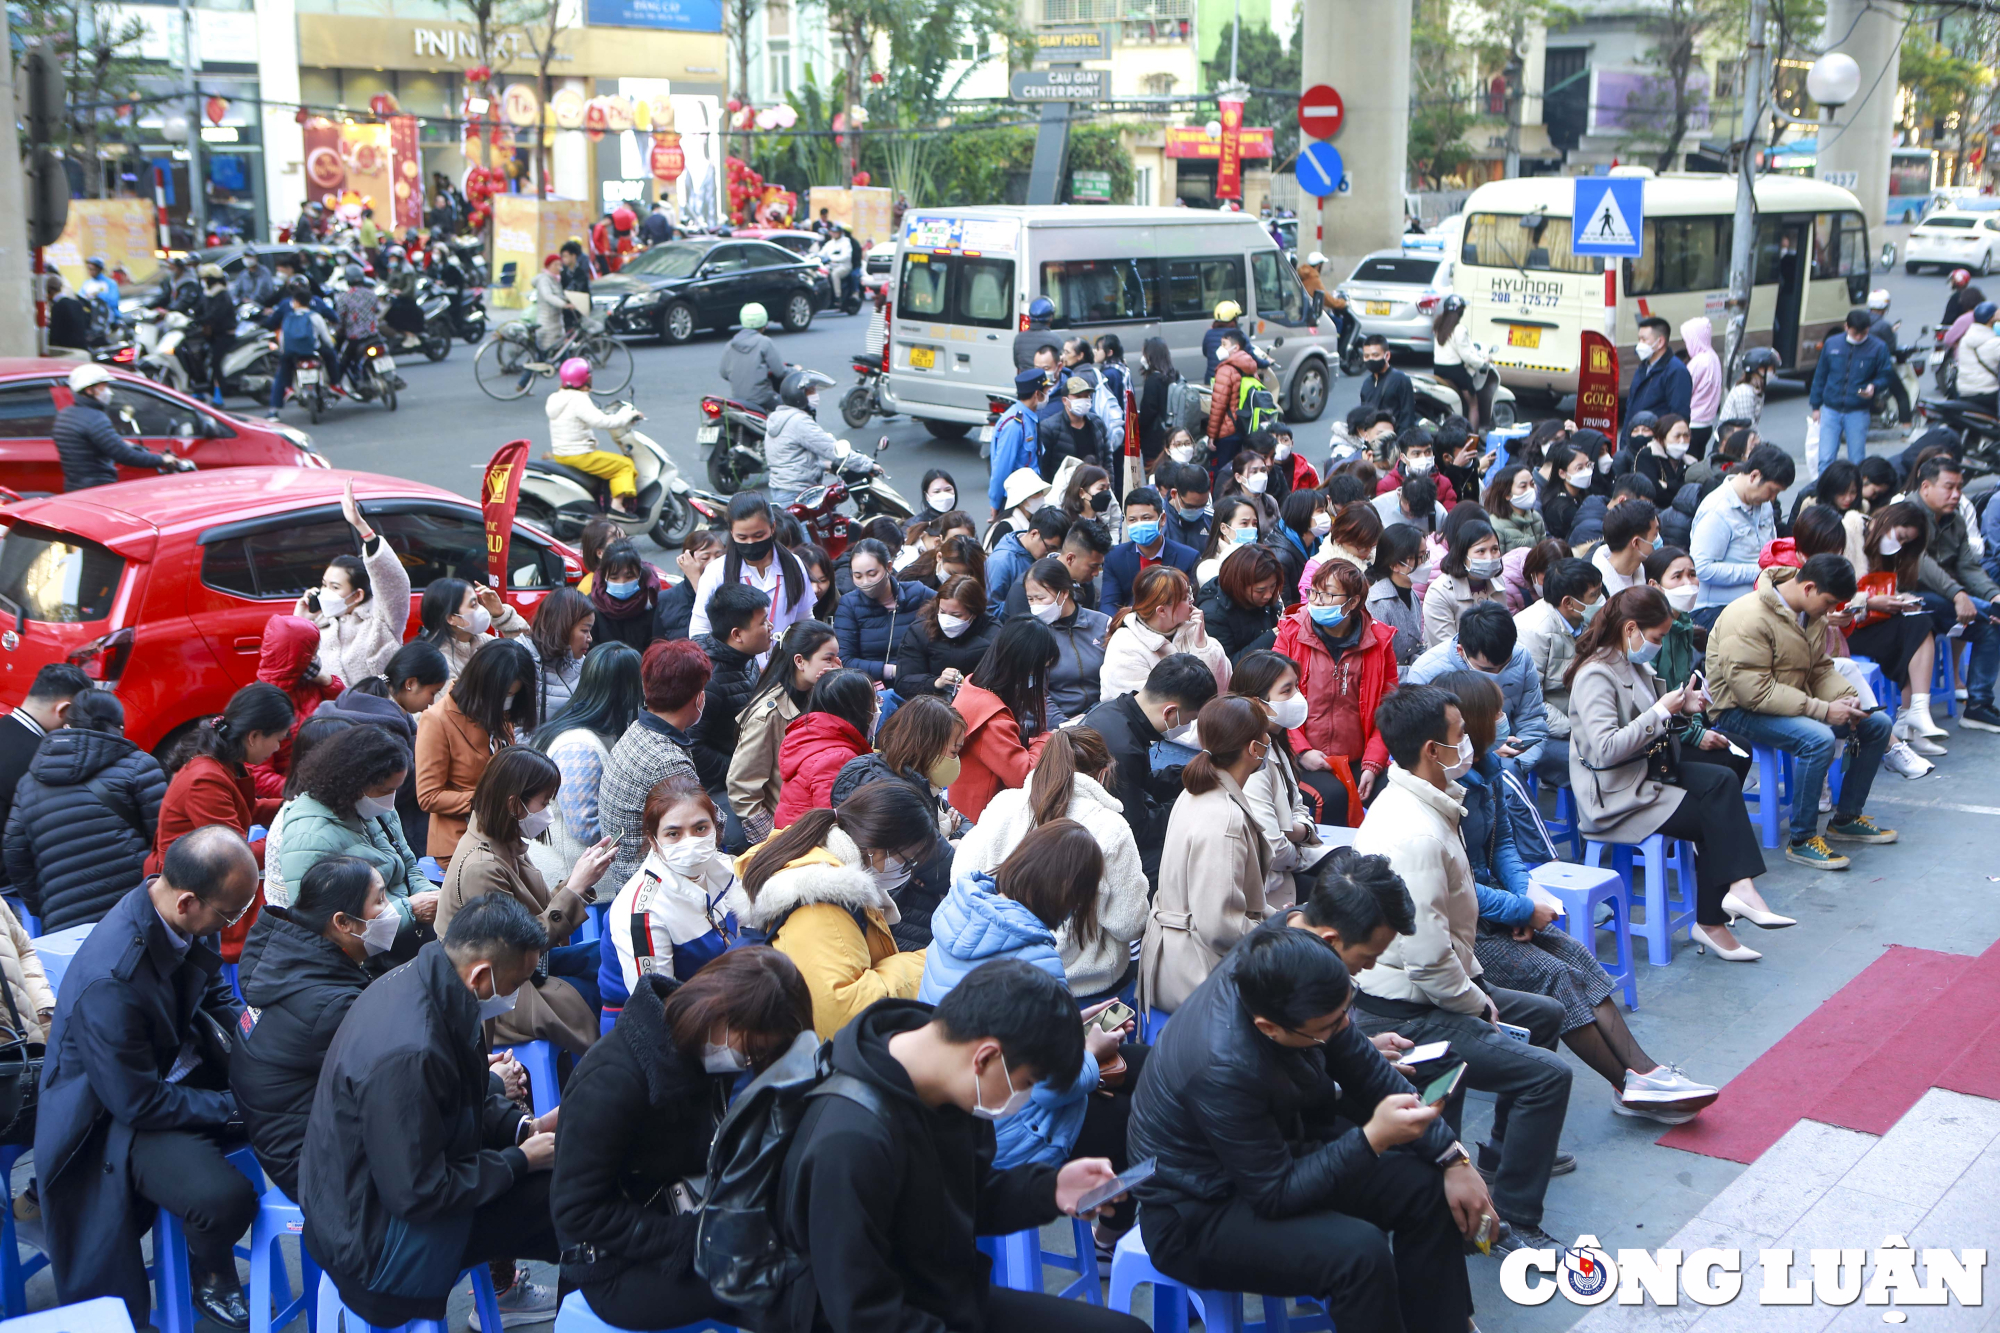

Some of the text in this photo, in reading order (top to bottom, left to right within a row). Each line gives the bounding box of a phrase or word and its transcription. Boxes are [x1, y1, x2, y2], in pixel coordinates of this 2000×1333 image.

[414, 28, 455, 62] PNJ
[1038, 34, 1062, 47] GIAY
[1063, 33, 1100, 46] HOTEL
[1048, 72, 1100, 85] CAU GIAY
[1491, 277, 1563, 295] HYUNDAI
[1522, 294, 1559, 307] 175.77
[1583, 391, 1615, 407] GOLD
